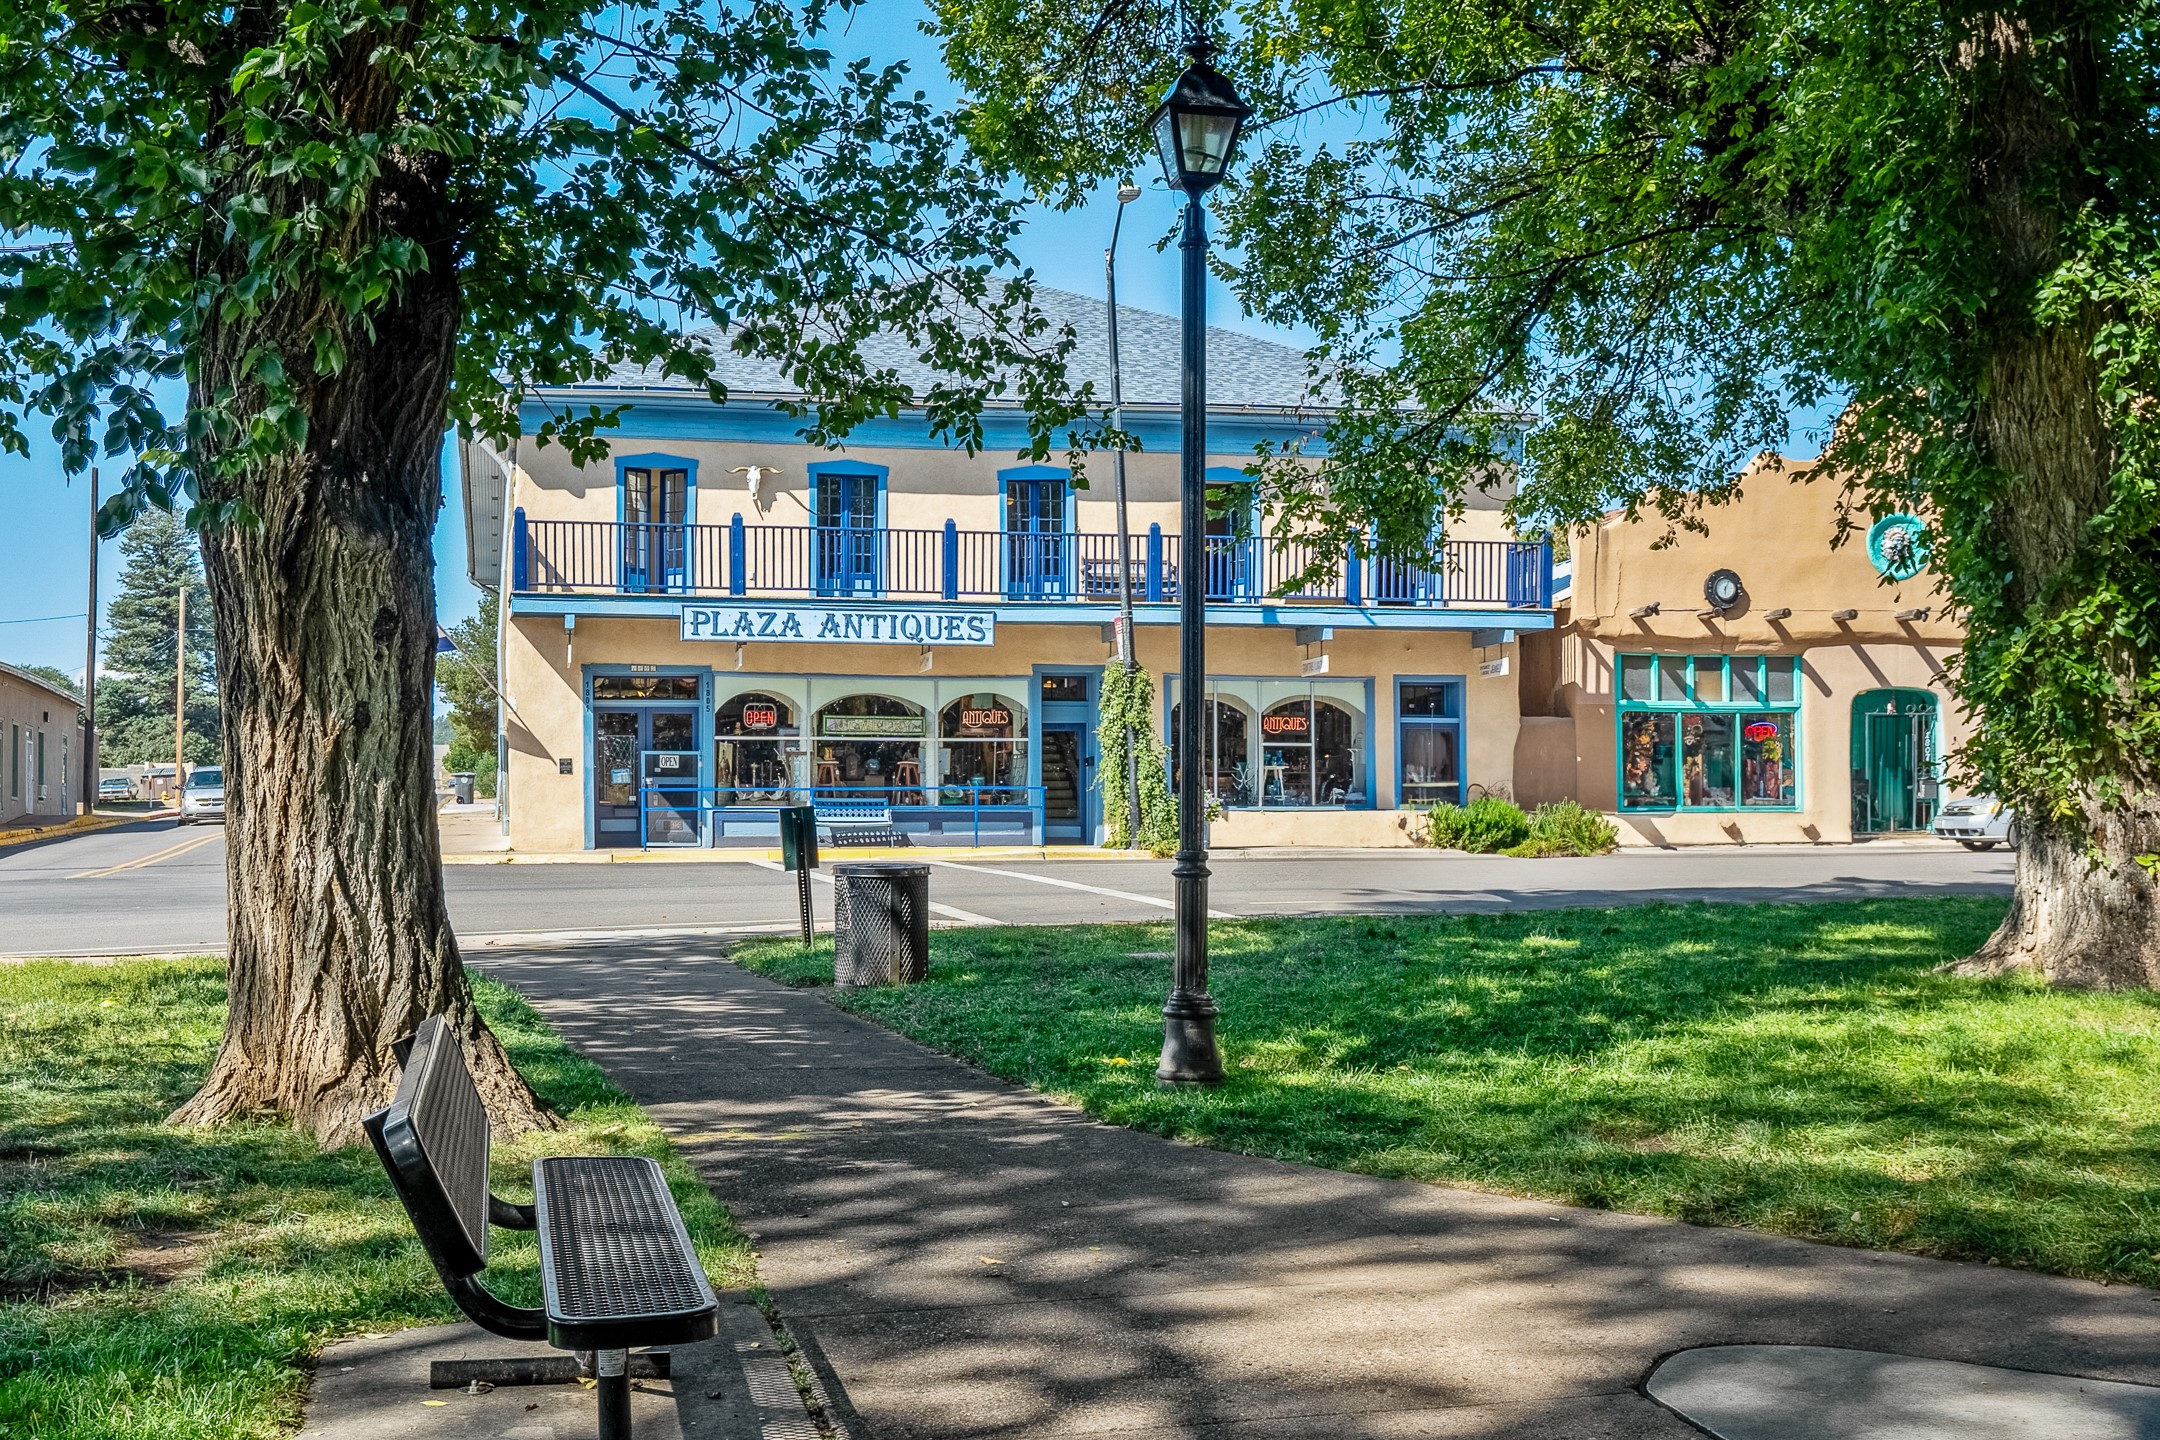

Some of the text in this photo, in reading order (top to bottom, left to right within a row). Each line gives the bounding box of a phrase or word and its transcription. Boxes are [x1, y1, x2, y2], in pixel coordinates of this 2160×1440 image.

[690, 610, 987, 643] PLAZA ANTIQUES
[746, 711, 774, 725] OPEN
[962, 710, 1009, 728] ANTIQUES
[1263, 716, 1307, 734] ANTIQUES
[1744, 725, 1776, 740] OPEN
[660, 756, 679, 767] OPEN
